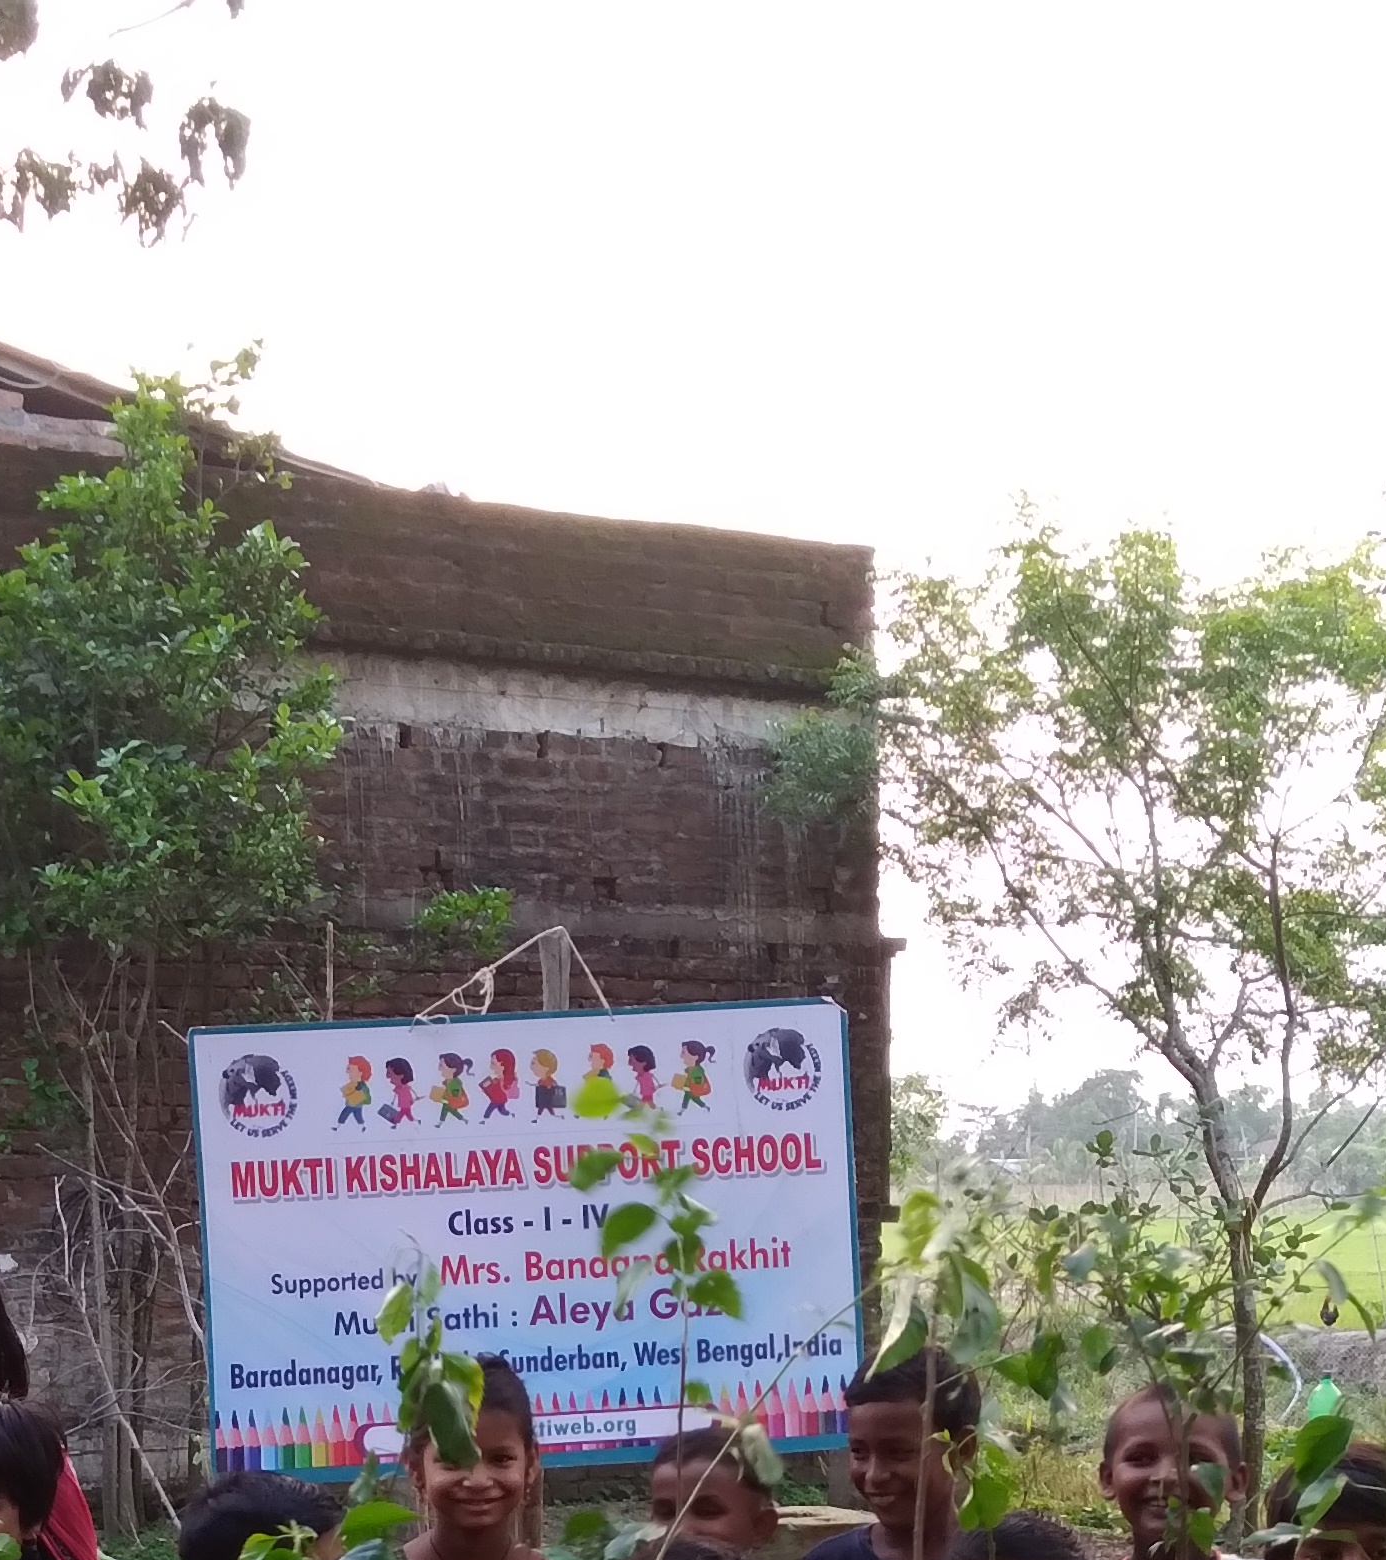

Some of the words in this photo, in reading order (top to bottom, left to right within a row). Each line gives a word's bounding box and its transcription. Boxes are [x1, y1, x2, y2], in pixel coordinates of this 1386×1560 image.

[757, 1070, 810, 1092] MUKTI
[233, 1098, 286, 1118] MUKTI
[230, 1156, 336, 1199] MUKTI
[344, 1147, 525, 1193] KISHALAYA
[532, 1139, 681, 1185] SUORT
[692, 1132, 823, 1175] SCHOOL
[447, 1208, 514, 1236] Class
[581, 1203, 610, 1230] IV
[270, 1267, 384, 1299] Supported
[440, 1254, 511, 1286] Mrs.
[334, 1308, 415, 1337] Mui
[529, 1292, 634, 1332] Aleya
[230, 1359, 383, 1390] Baradanagar,
[632, 1342, 687, 1368] Wes
[534, 1415, 637, 1437] tiweb.org
